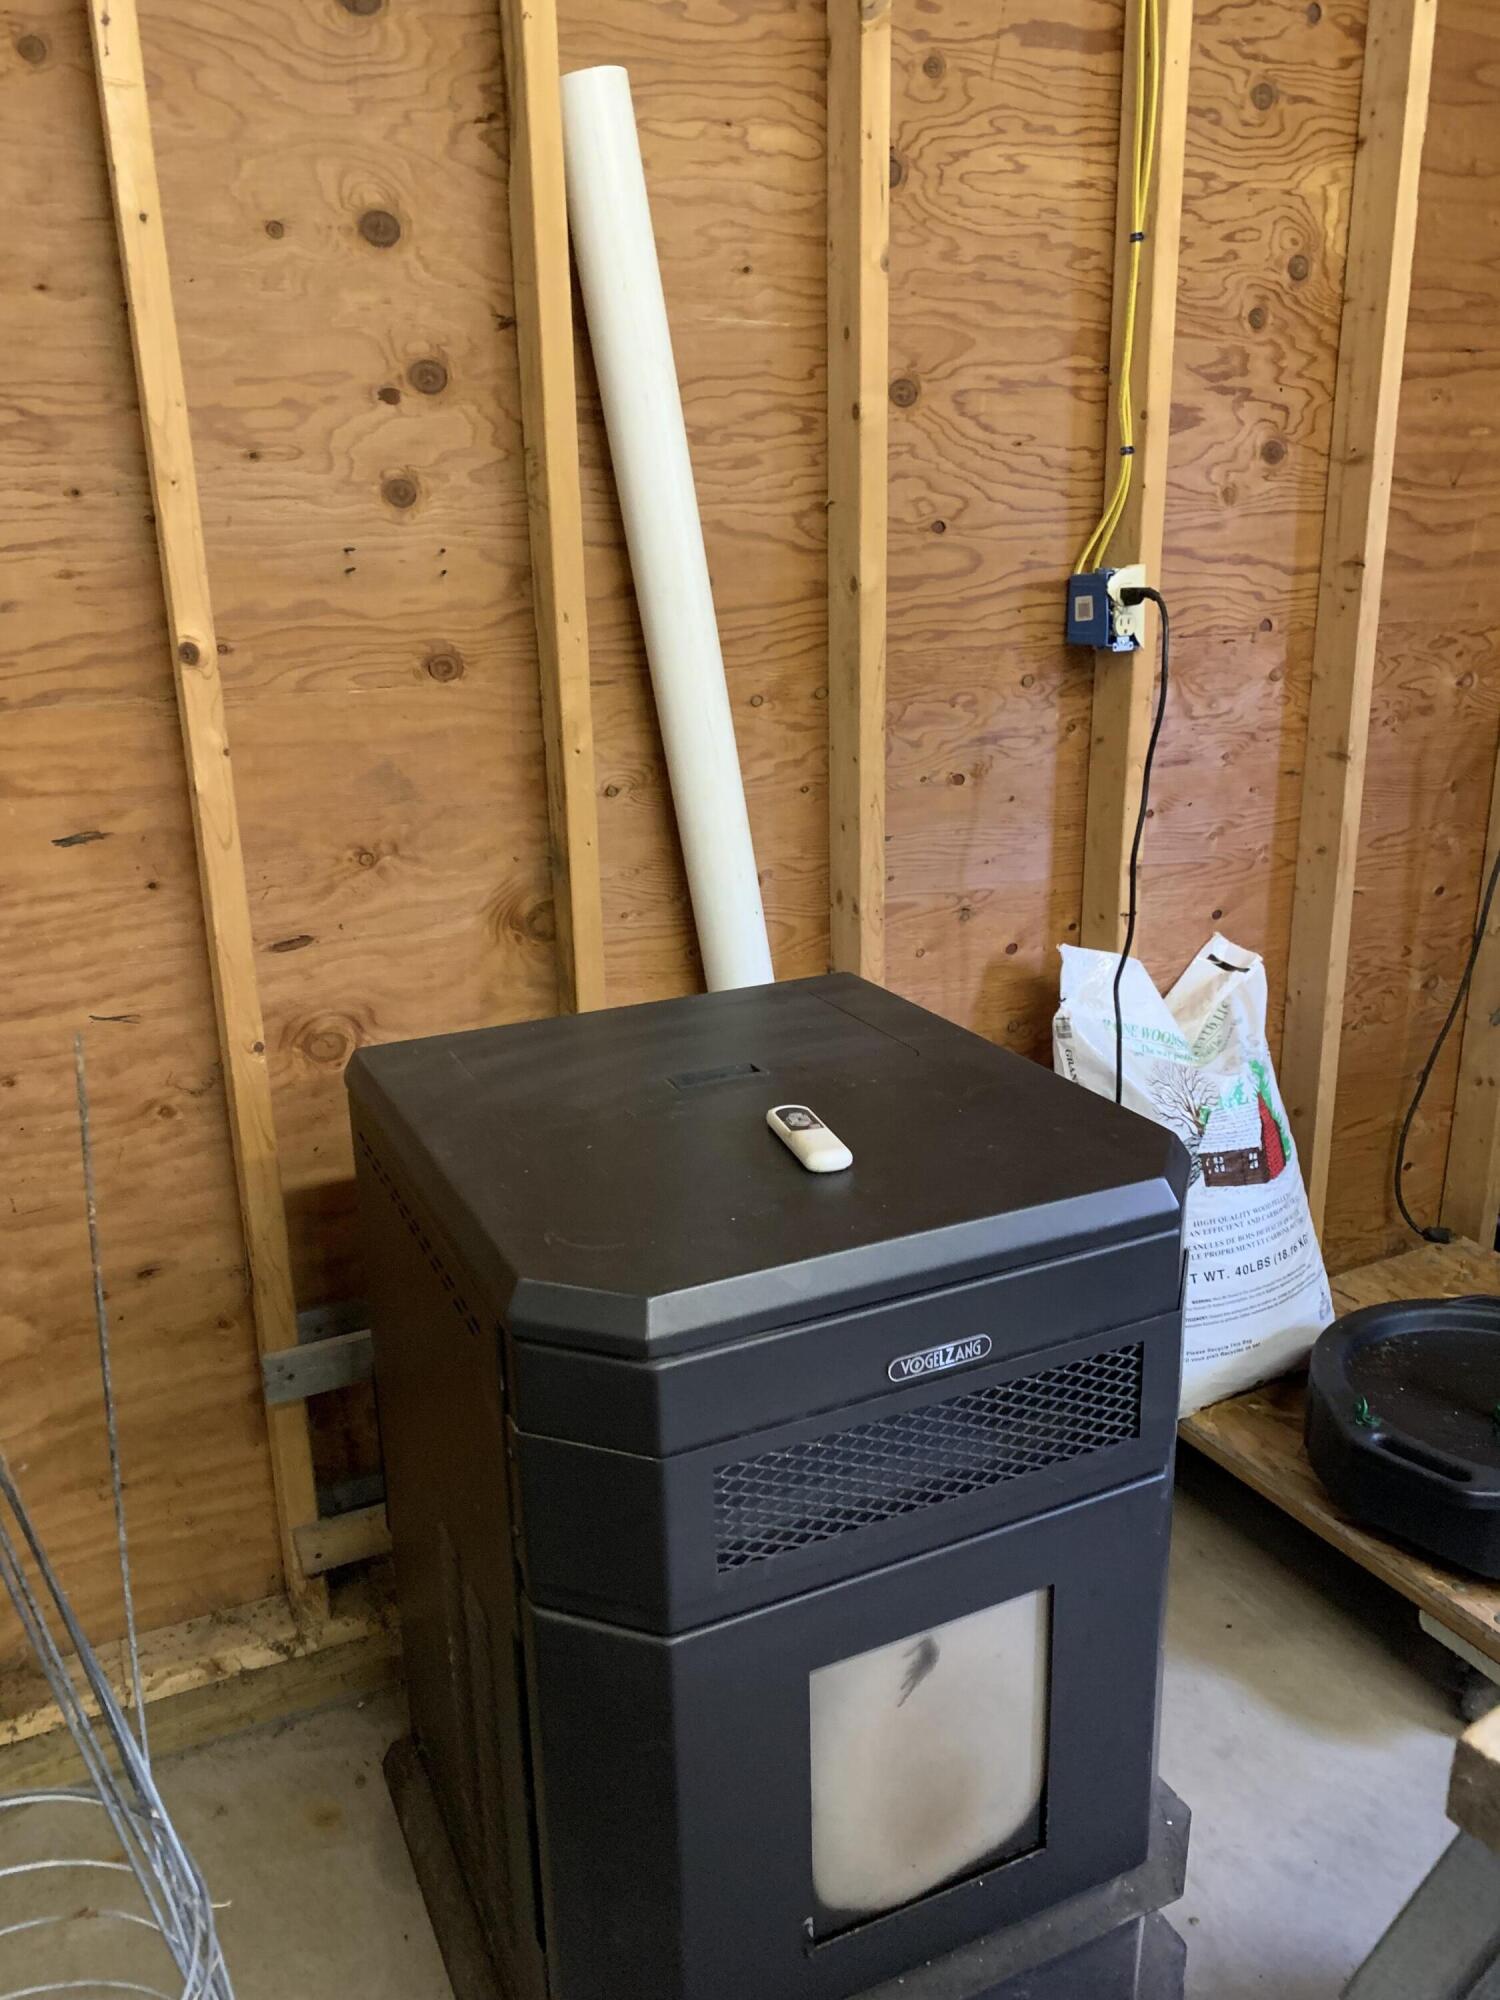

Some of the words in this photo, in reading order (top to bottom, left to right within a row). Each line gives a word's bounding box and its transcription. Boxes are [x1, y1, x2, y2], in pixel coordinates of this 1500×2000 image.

[1193, 1218, 1217, 1228] HIGH
[1217, 1211, 1251, 1225] QUALITY
[1201, 1221, 1244, 1236] EFFICIENT
[1203, 1269, 1230, 1282] WT.
[1235, 1256, 1272, 1277] 40LBS
[901, 1339, 982, 1375] VOGELZANG
